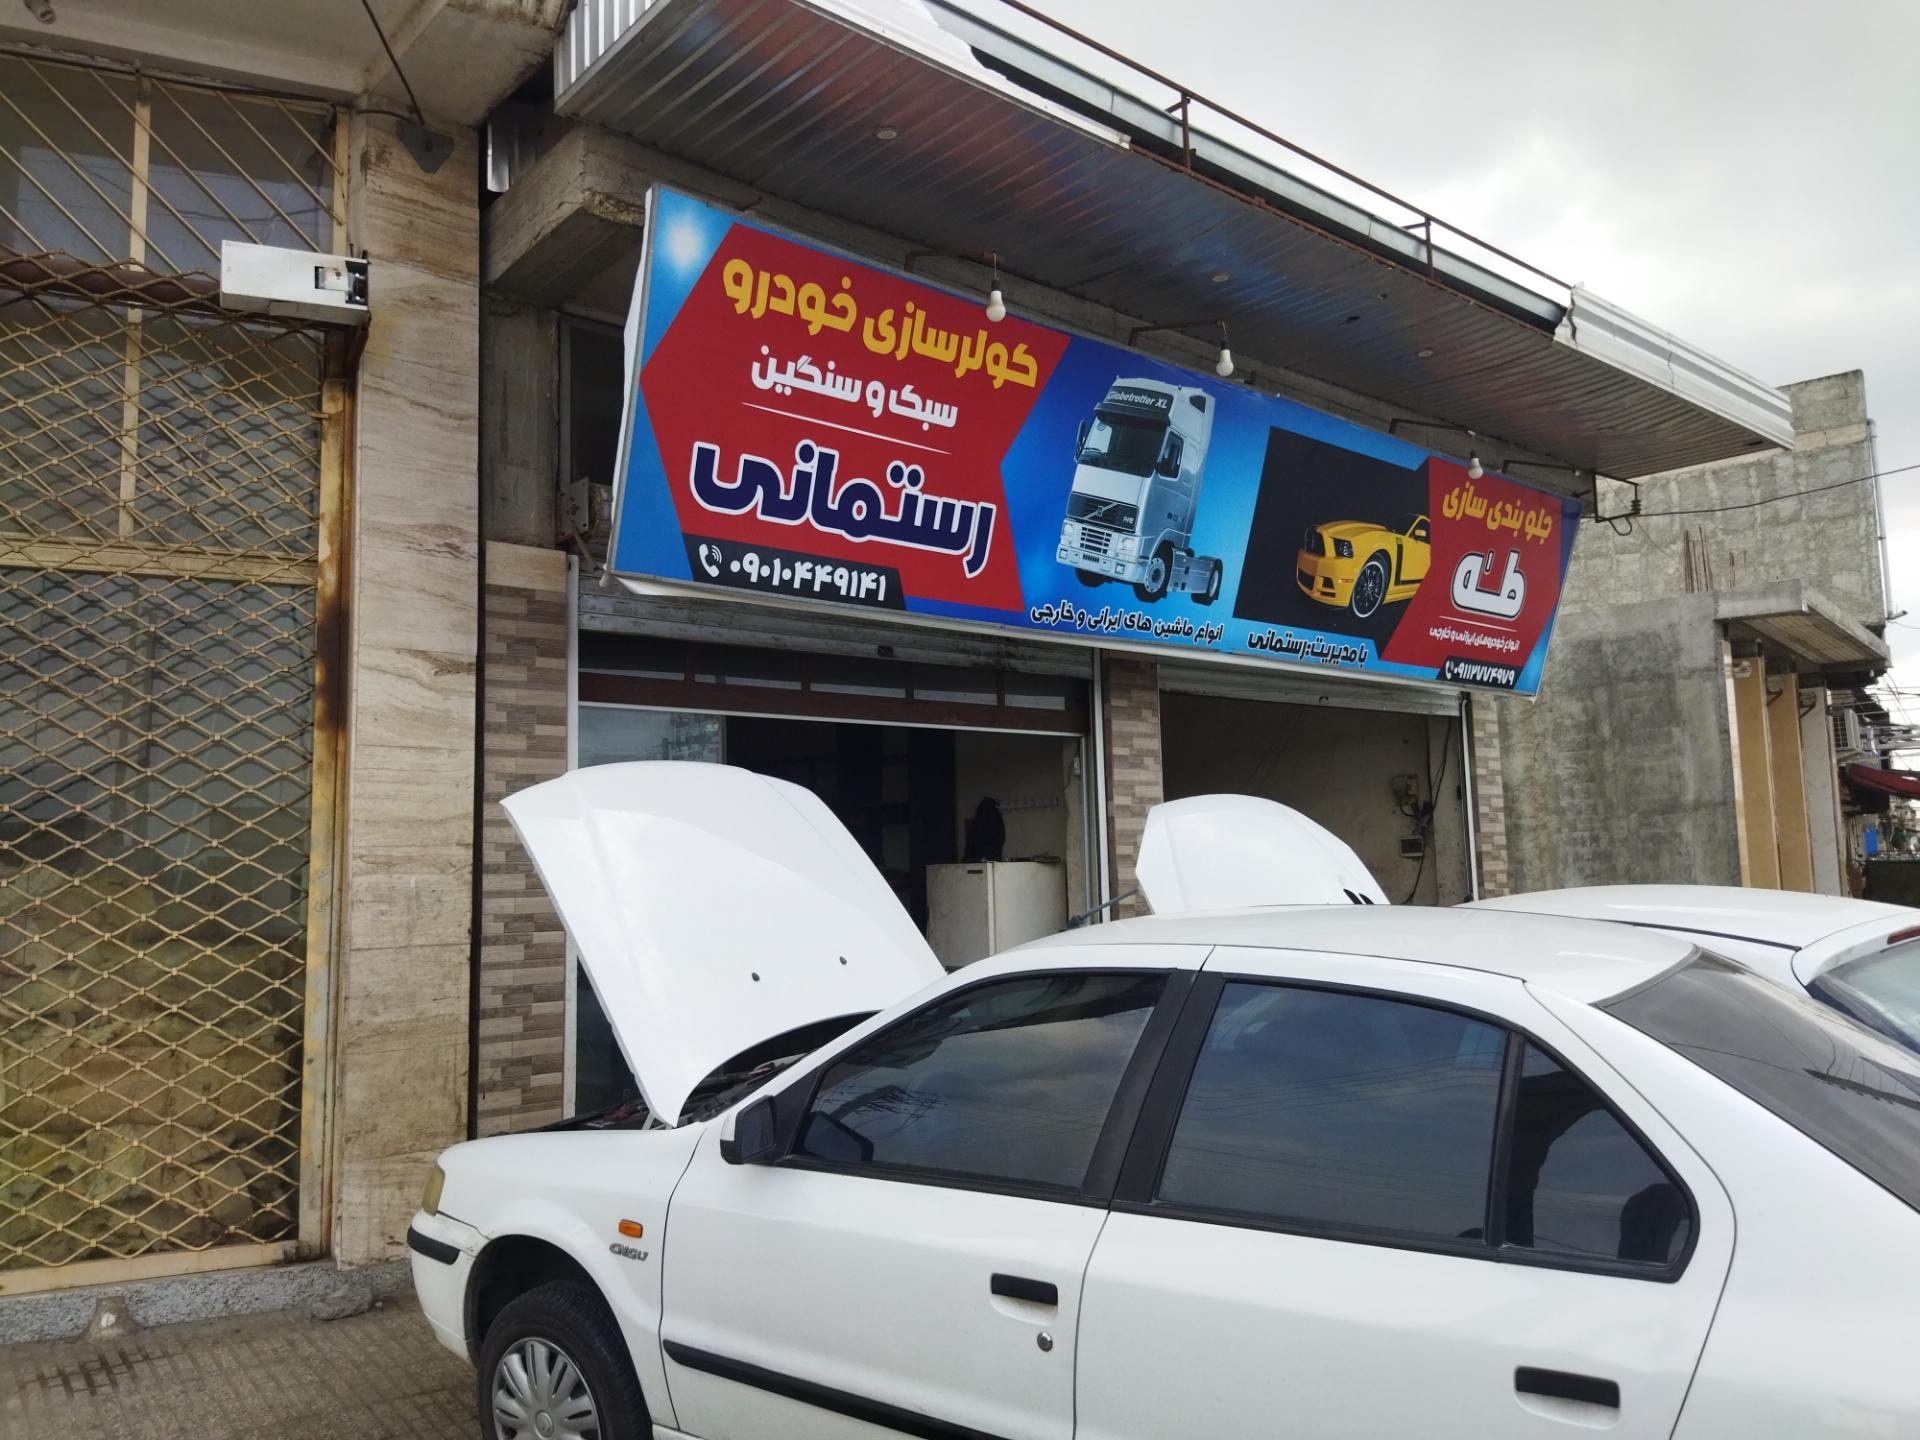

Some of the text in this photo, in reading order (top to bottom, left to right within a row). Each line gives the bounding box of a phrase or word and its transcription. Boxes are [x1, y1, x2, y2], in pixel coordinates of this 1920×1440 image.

[723, 258, 858, 335] خودرو
[751, 345, 958, 431] سبک و سنگین
[1107, 391, 1168, 409] Globetrotter XL
[689, 438, 997, 579] رستمانی
[1442, 480, 1553, 545] جلو بندی سازی
[730, 552, 887, 602] ۰۹۰۱۰۴۴۹۱۴۱
[1031, 600, 1224, 644] انواع ماشین های ایرانی و خارجی
[1359, 642, 1368, 668] با
